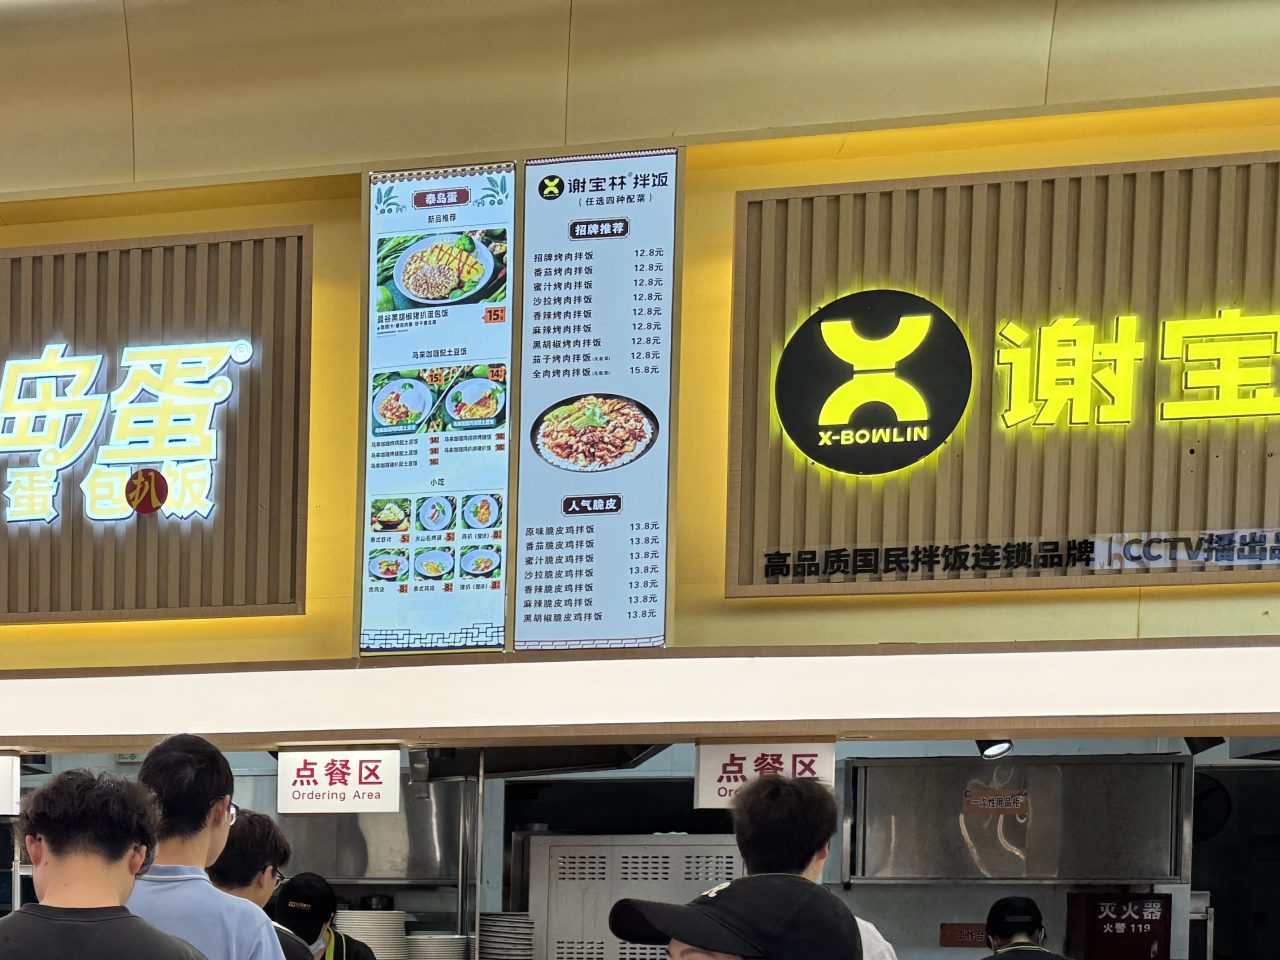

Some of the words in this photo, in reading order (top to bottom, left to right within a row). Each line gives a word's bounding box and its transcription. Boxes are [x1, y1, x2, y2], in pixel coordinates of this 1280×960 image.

[575, 222, 625, 236] 招牌推荐
[534, 251, 594, 262] 招牌烤肉拌饭
[634, 248, 664, 258] 12.8元
[534, 266, 593, 277] 番茄烤肉拌饭
[634, 262, 664, 272] 12.8元
[533, 281, 593, 292] 蜜汁烤肉拌饭
[633, 277, 663, 287] 12.8元
[533, 295, 592, 306] 沙拉烤肉拌饭
[633, 292, 663, 302] 12.8元
[533, 310, 592, 321] 香辣烤肉拌饭
[632, 307, 662, 317] 12.8元
[532, 324, 592, 335] 麻辣烤肉拌饭
[632, 322, 662, 332] 12.8元
[533, 338, 602, 349] 黑胡椒烤肉拌饭
[631, 336, 661, 345] 12.8元
[532, 353, 591, 364] 茄子烤肉拌饭
[630, 351, 661, 360] 12.8元
[532, 368, 591, 379] 全肉烤肉拌饭
[629, 365, 660, 375] 15.8元
[997, 309, 1280, 428] 谢宝
[818, 426, 928, 446] X-BOWLIN
[431, 478, 445, 486] 小吃
[568, 499, 617, 512] 人气脆皮
[525, 525, 595, 537] 原味脆皮鸡拌饭
[629, 521, 660, 531] 13.8元
[526, 539, 595, 551] 番茄脆皮鸡拌饭
[629, 536, 660, 546] 13.8元
[525, 554, 594, 566] 蜜汁脆皮鸡拌饭
[629, 550, 659, 560] 13.8元
[764, 537, 1095, 578] 高品质国民拌饭连锁品牌
[524, 568, 594, 580] 沙拉脆皮鸡拌饭
[629, 565, 659, 575] 13.8元
[524, 583, 593, 595] 香辣脆皮鸡拌饭
[628, 579, 658, 589] 13.8元
[523, 598, 593, 609] 麻辣脆皮鸡拌饭
[628, 594, 658, 604] 13.8元
[523, 612, 603, 624] 黑胡椒脆皮鸡拌饭
[627, 609, 657, 619] 13.8元
[291, 759, 383, 787] 点餐区
[292, 790, 346, 801] Ordering
[353, 790, 381, 800] Area
[1098, 902, 1162, 920] 灭火器
[1103, 922, 1126, 934] 火警
[1131, 923, 1151, 933] 119
